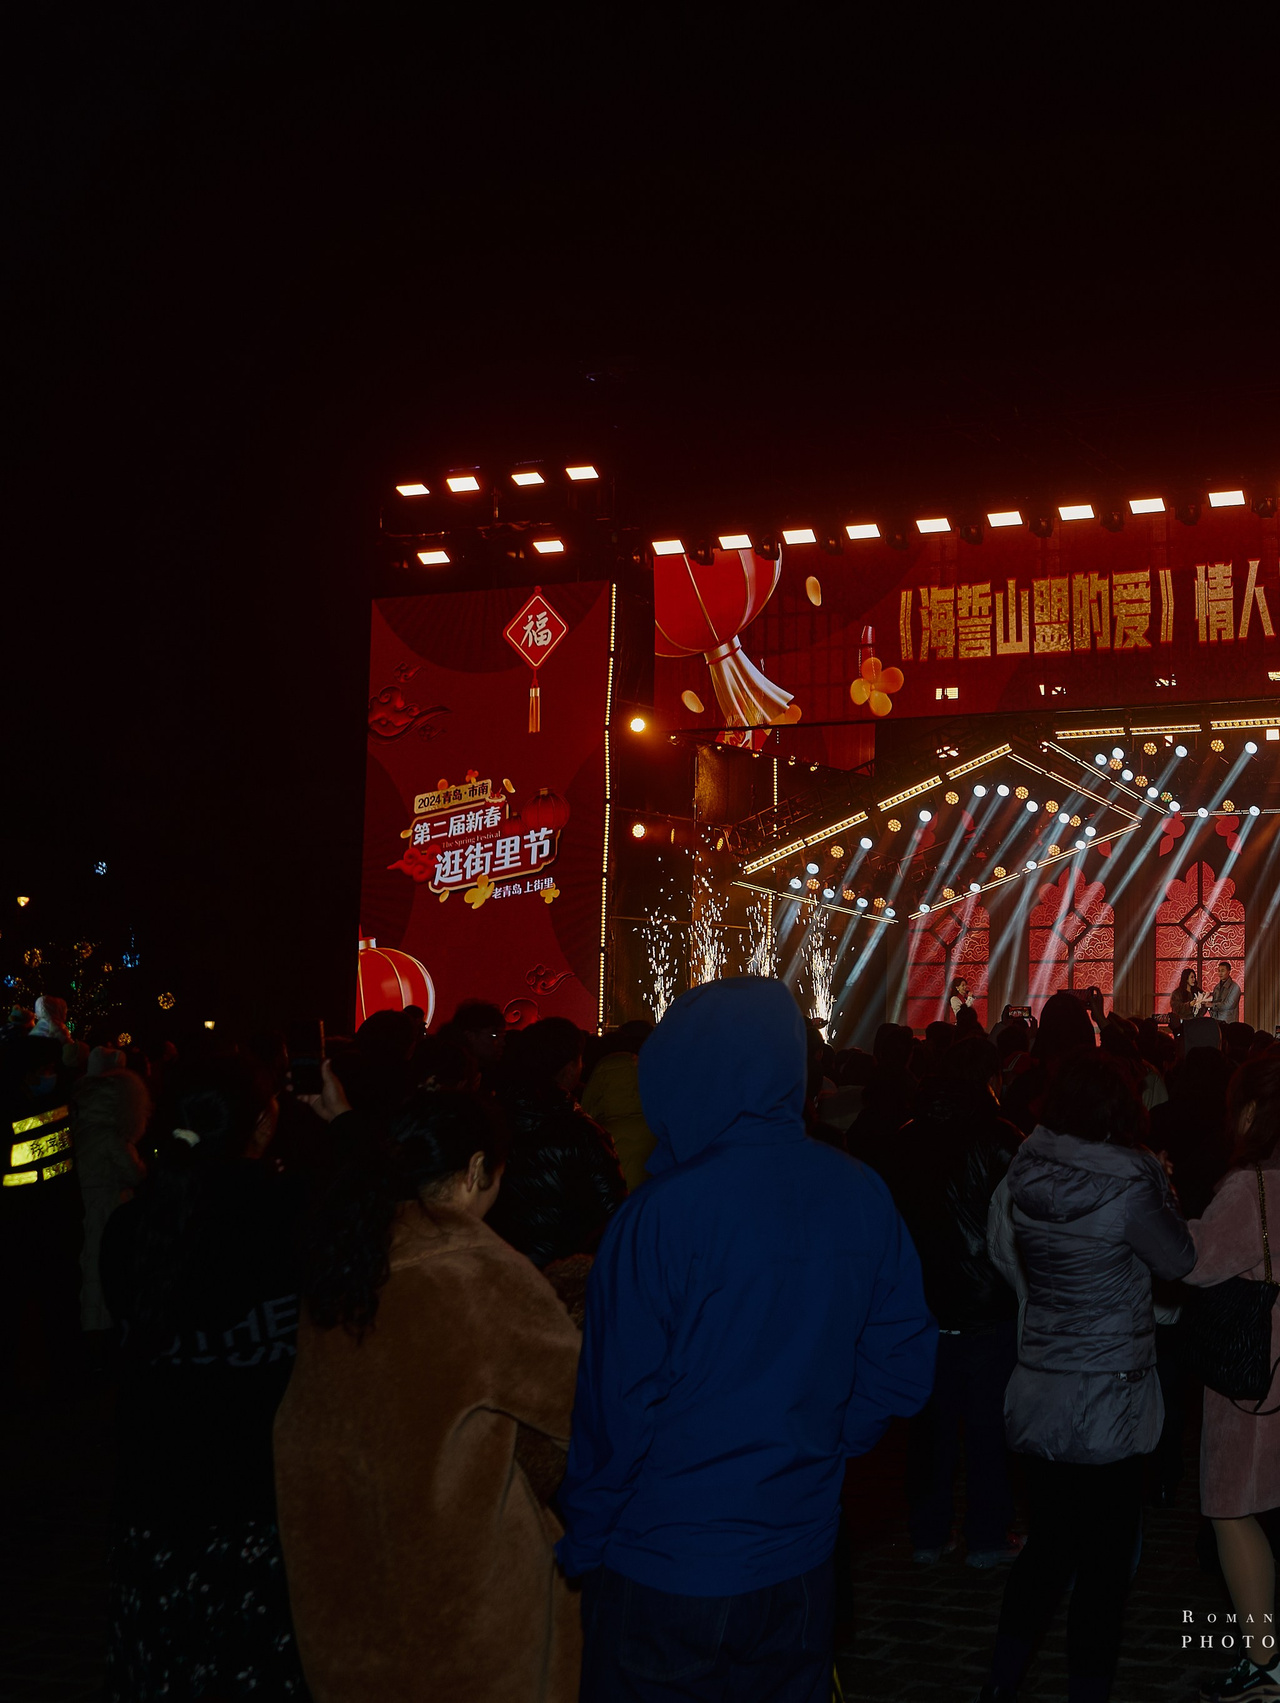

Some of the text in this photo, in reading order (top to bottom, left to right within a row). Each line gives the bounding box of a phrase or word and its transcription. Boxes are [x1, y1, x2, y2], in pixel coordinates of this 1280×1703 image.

[519, 610, 552, 648] 福
[900, 568, 1174, 661] 《海誓山盟的爱》
[413, 806, 502, 846] 第二届新春
[433, 826, 554, 887] 逛街里节
